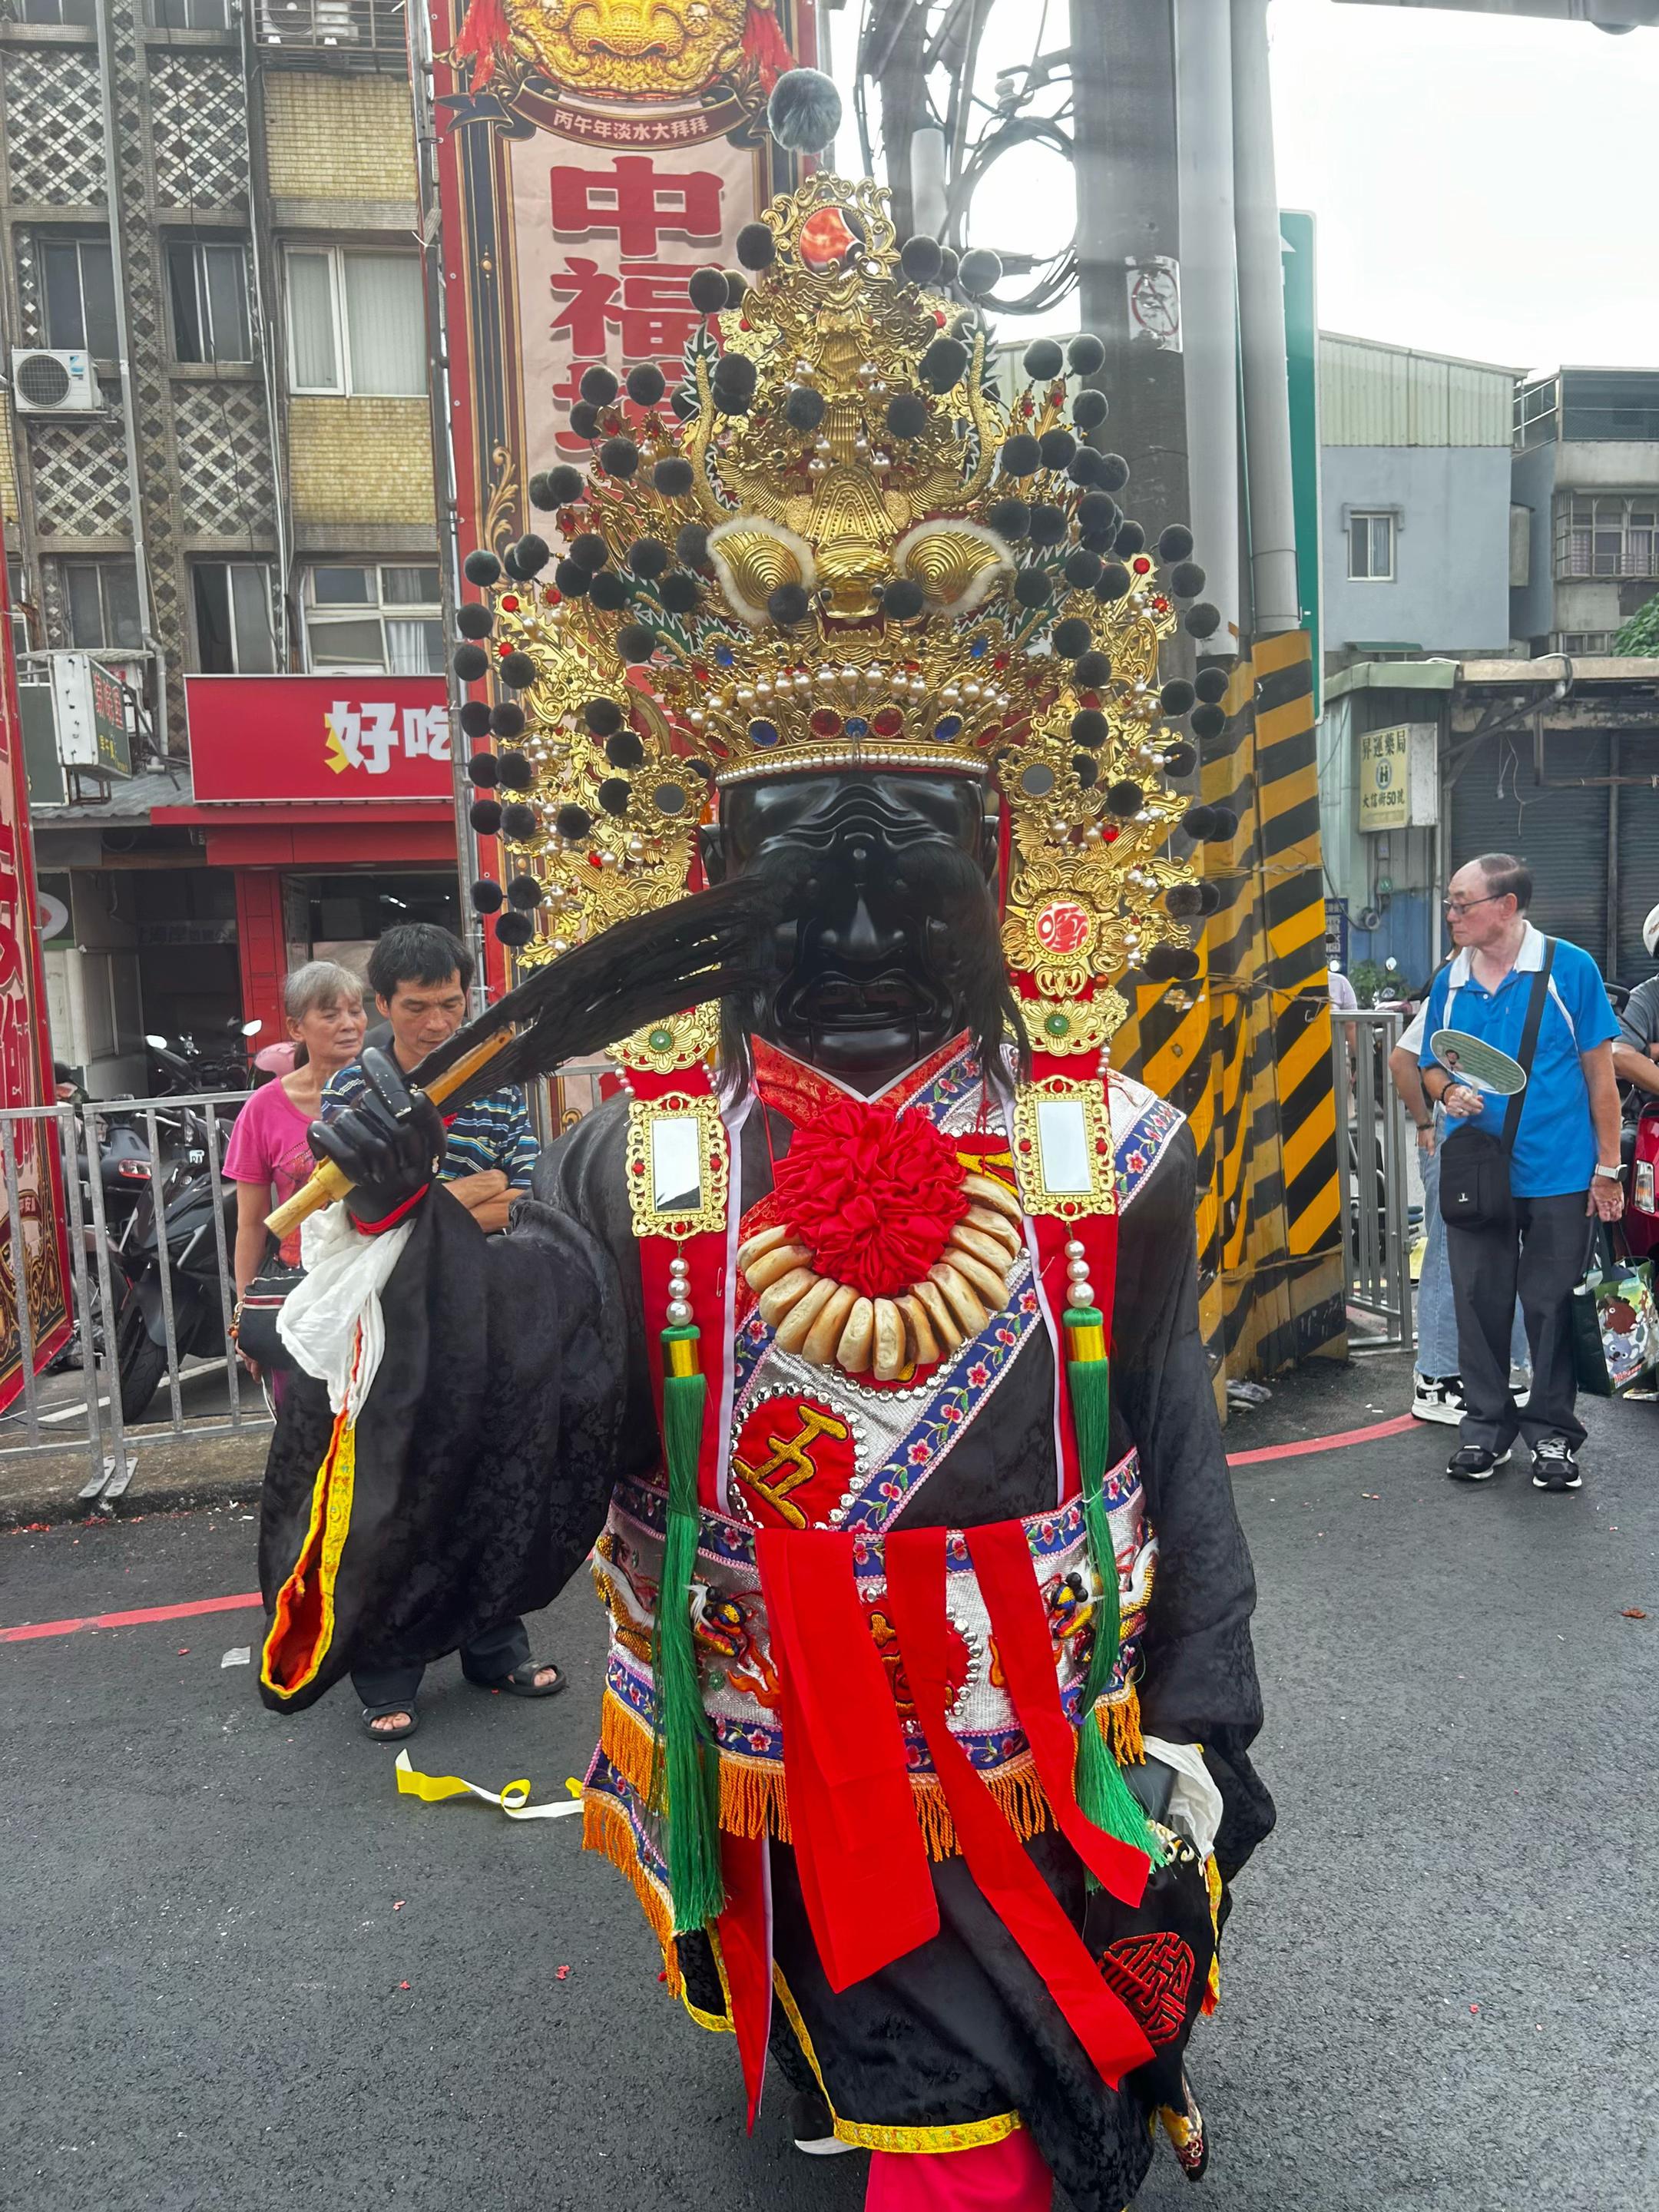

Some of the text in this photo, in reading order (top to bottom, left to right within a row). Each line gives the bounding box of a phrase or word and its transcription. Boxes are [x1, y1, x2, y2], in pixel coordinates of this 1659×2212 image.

[552, 108, 710, 141] 丙午年淡水大拜拜
[324, 700, 452, 774] 好吃
